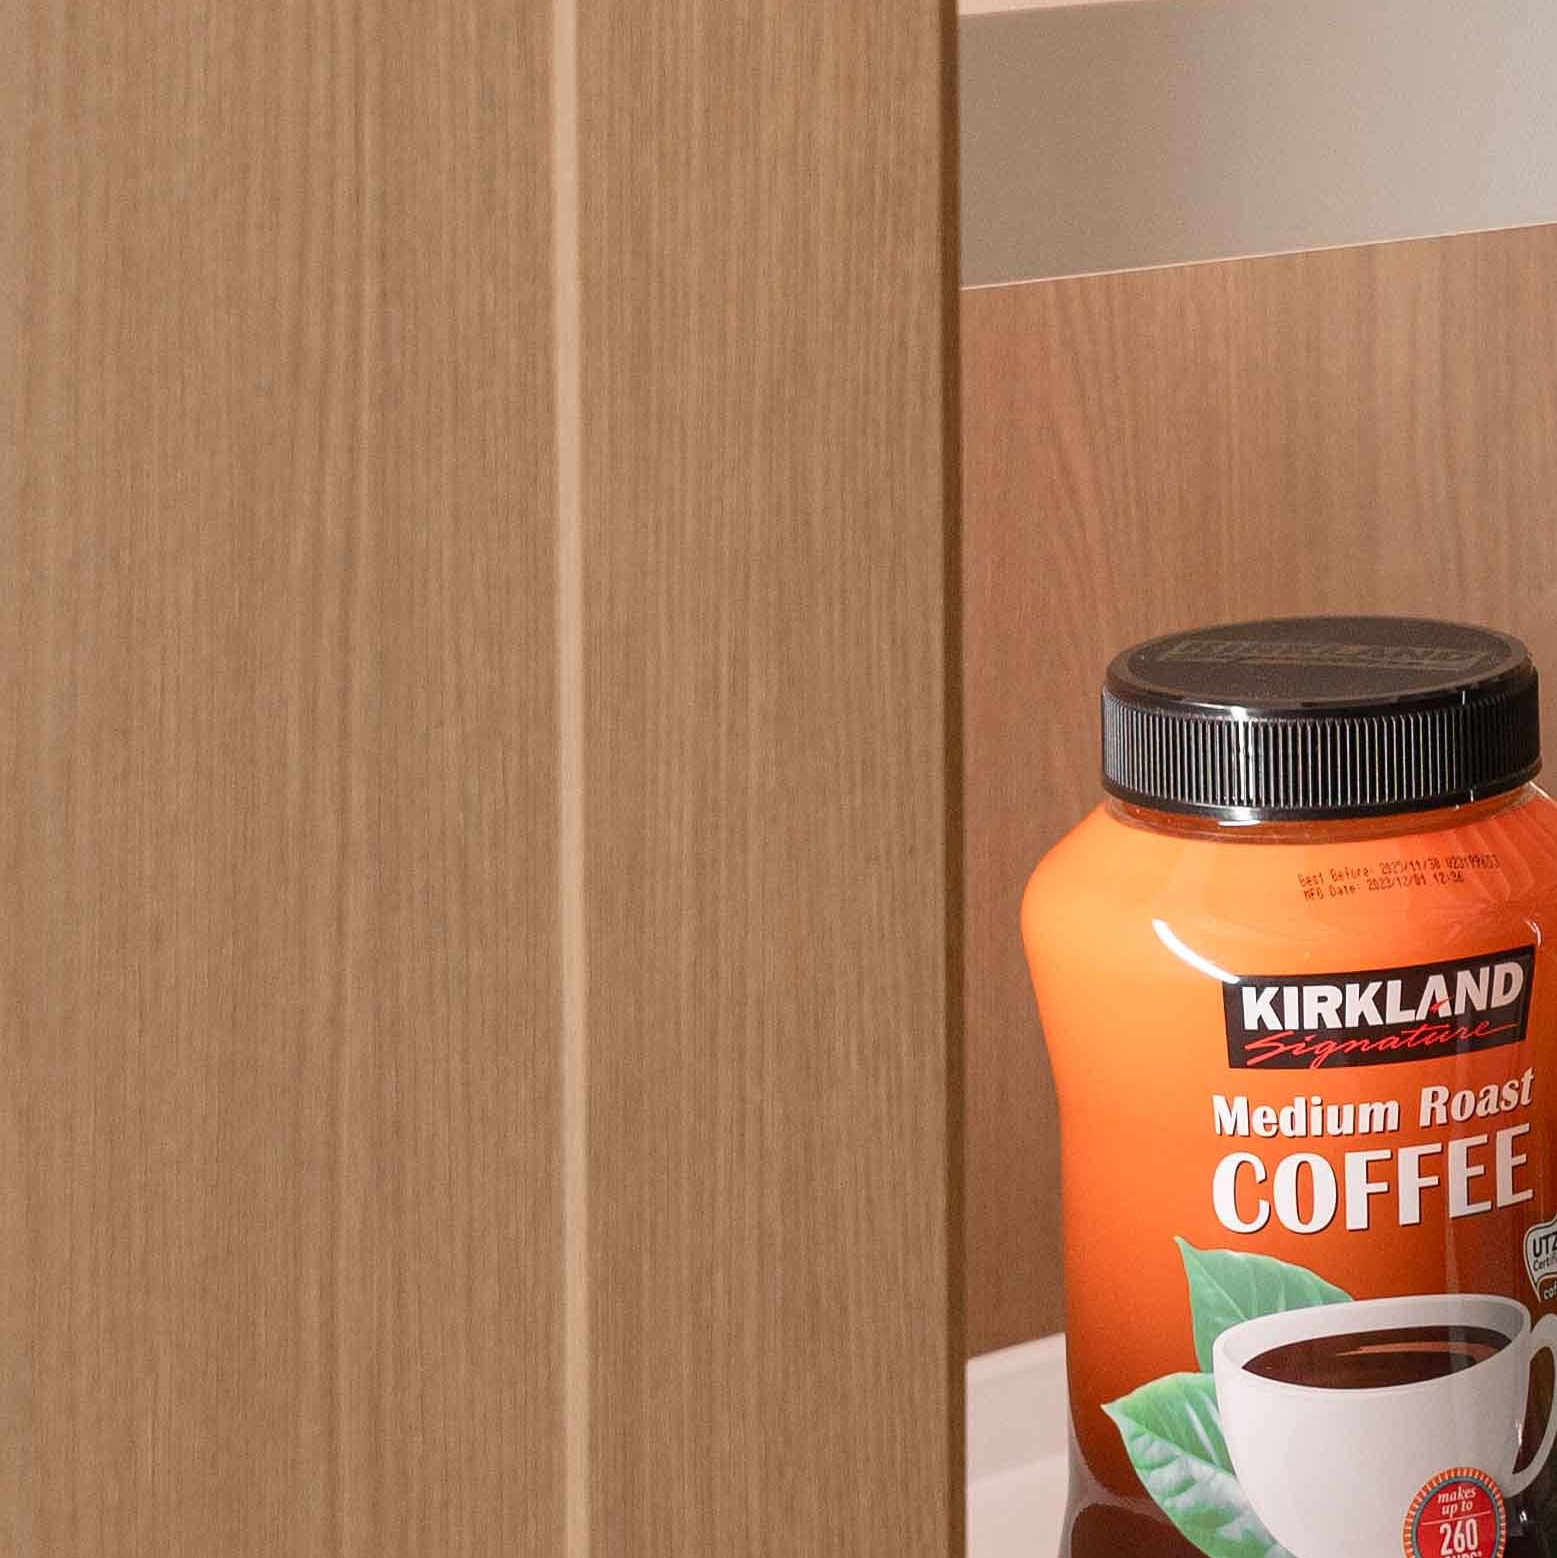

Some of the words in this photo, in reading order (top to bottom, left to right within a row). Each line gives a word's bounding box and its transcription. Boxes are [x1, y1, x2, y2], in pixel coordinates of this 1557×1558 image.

[1297, 872, 1325, 889] Best
[1240, 960, 1526, 1032] KIRKLAND
[1244, 1019, 1520, 1070] Signature
[1211, 1093, 1401, 1139] Medium
[1418, 1066, 1537, 1129] Roast
[1211, 1122, 1536, 1236] COFFEE
[1437, 1485, 1477, 1504] makes
[1441, 1503, 1459, 1519] up
[1460, 1500, 1474, 1513] to
[1439, 1517, 1479, 1557] 260
